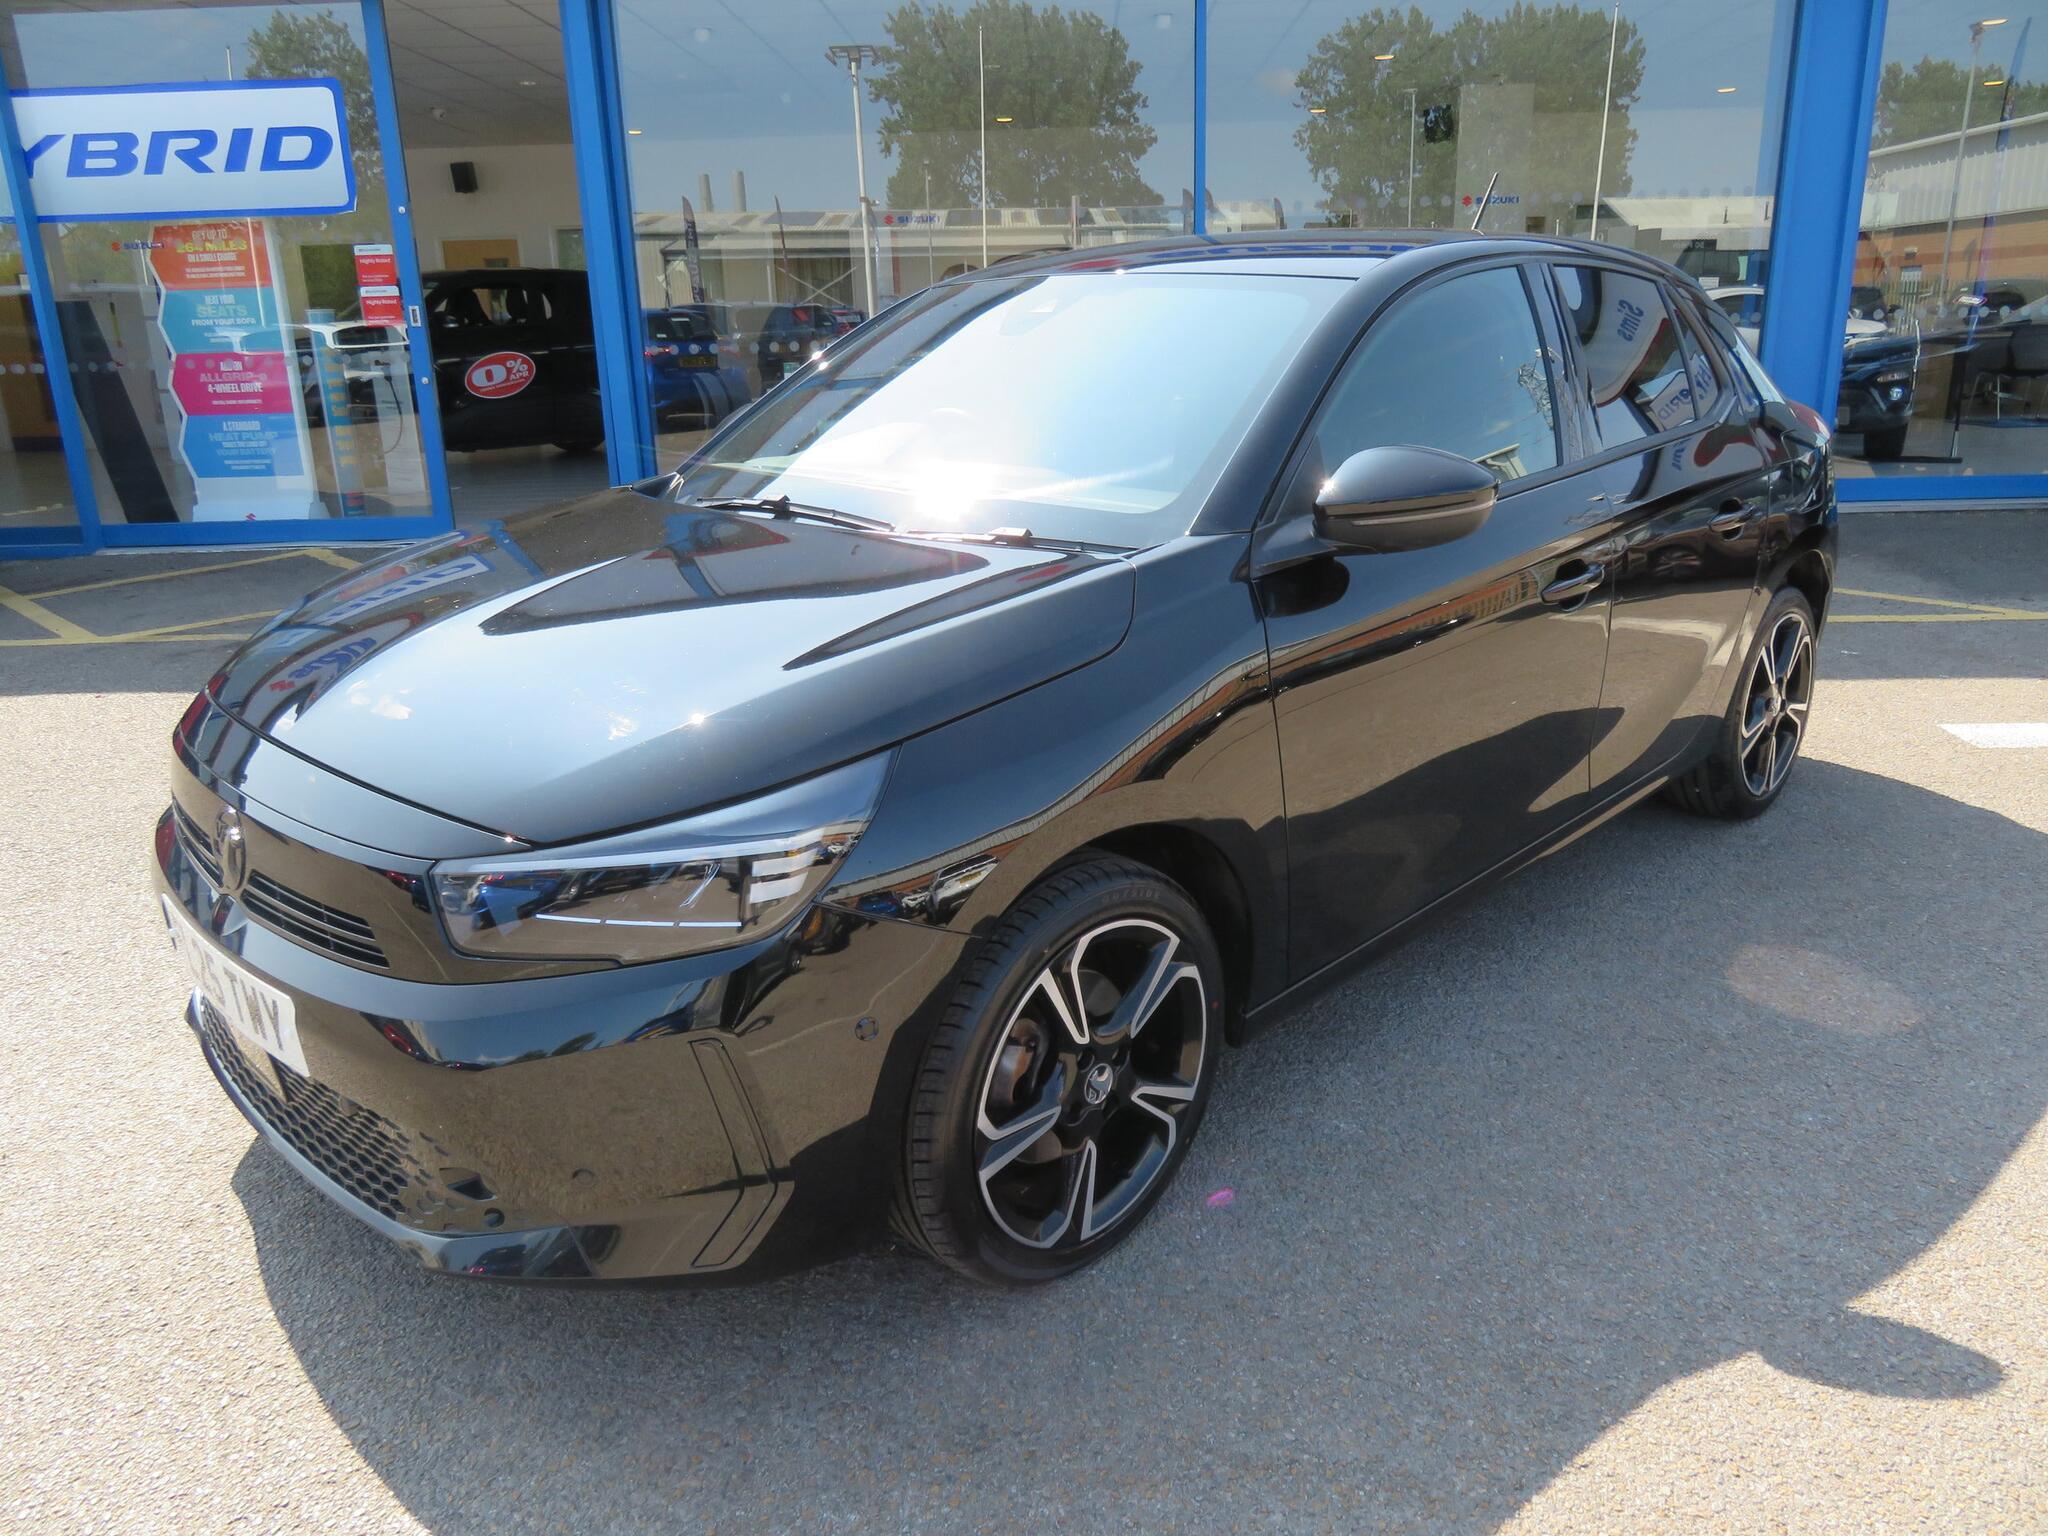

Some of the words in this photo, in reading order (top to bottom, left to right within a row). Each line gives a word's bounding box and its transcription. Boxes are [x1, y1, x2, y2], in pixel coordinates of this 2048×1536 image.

[1475, 195, 1520, 205] SZUKI
[897, 215, 940, 224] SUZUKI
[196, 304, 248, 318] SEATS
[207, 383, 240, 393] 4-WHEEL
[240, 382, 263, 392] DRIVE
